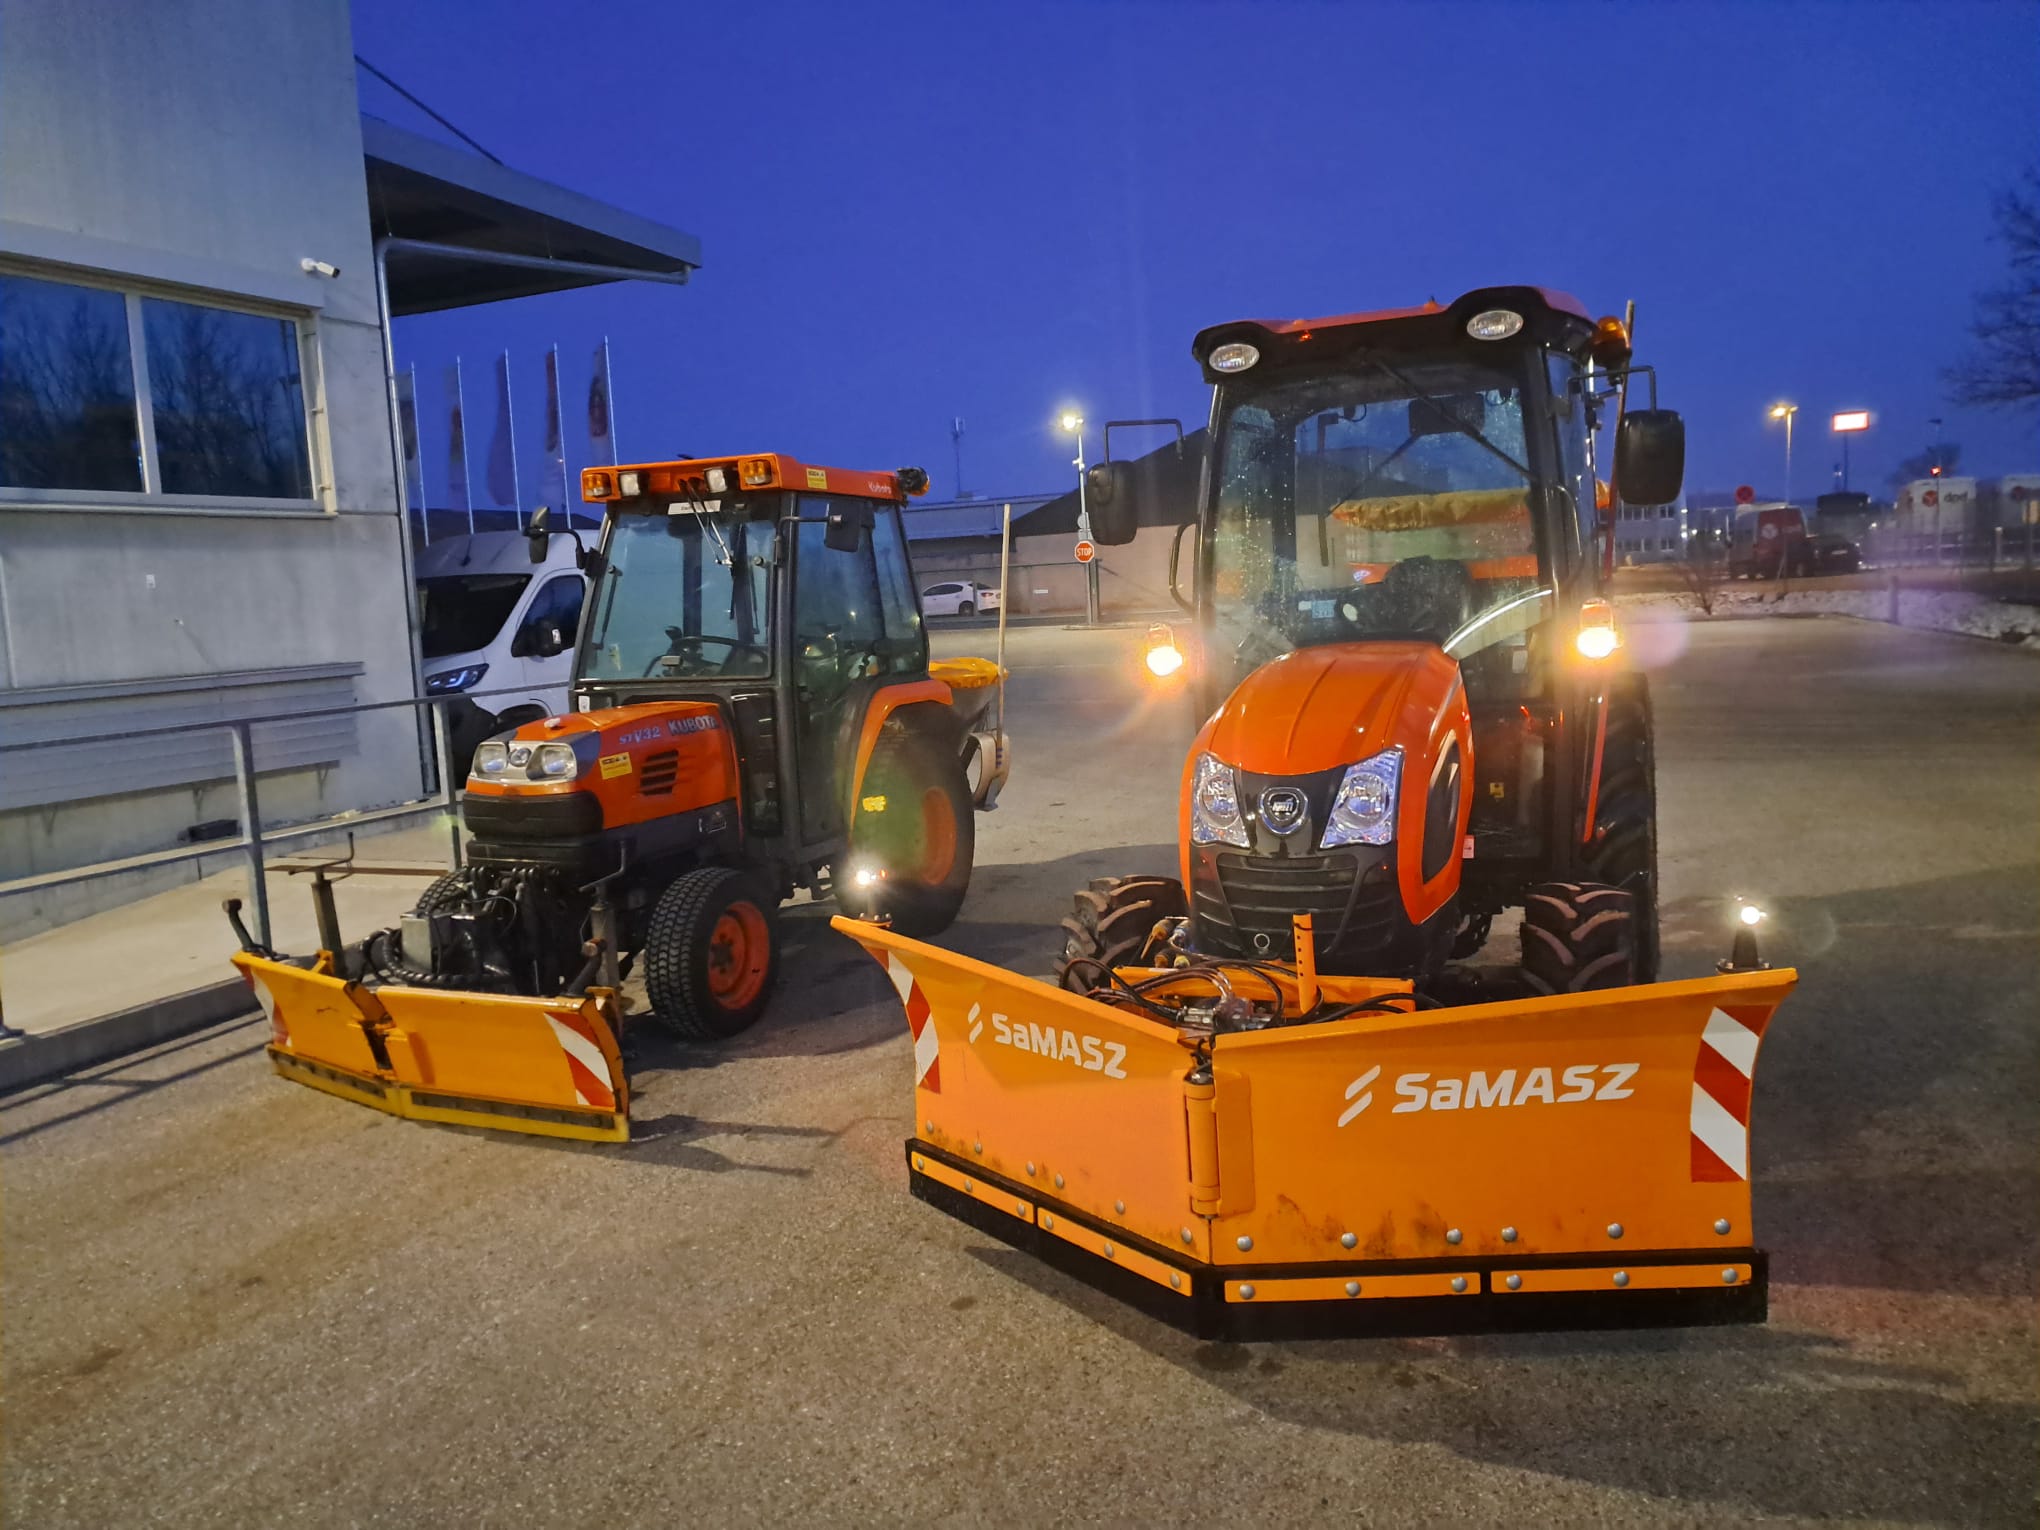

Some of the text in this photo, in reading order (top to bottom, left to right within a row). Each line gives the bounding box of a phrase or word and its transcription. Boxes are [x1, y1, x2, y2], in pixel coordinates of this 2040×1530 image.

[1076, 547, 1092, 557] STOP
[667, 715, 718, 735] KUBOTA
[992, 1013, 1127, 1079] SaMASZ
[1392, 1063, 1640, 1113] SaMASZ
